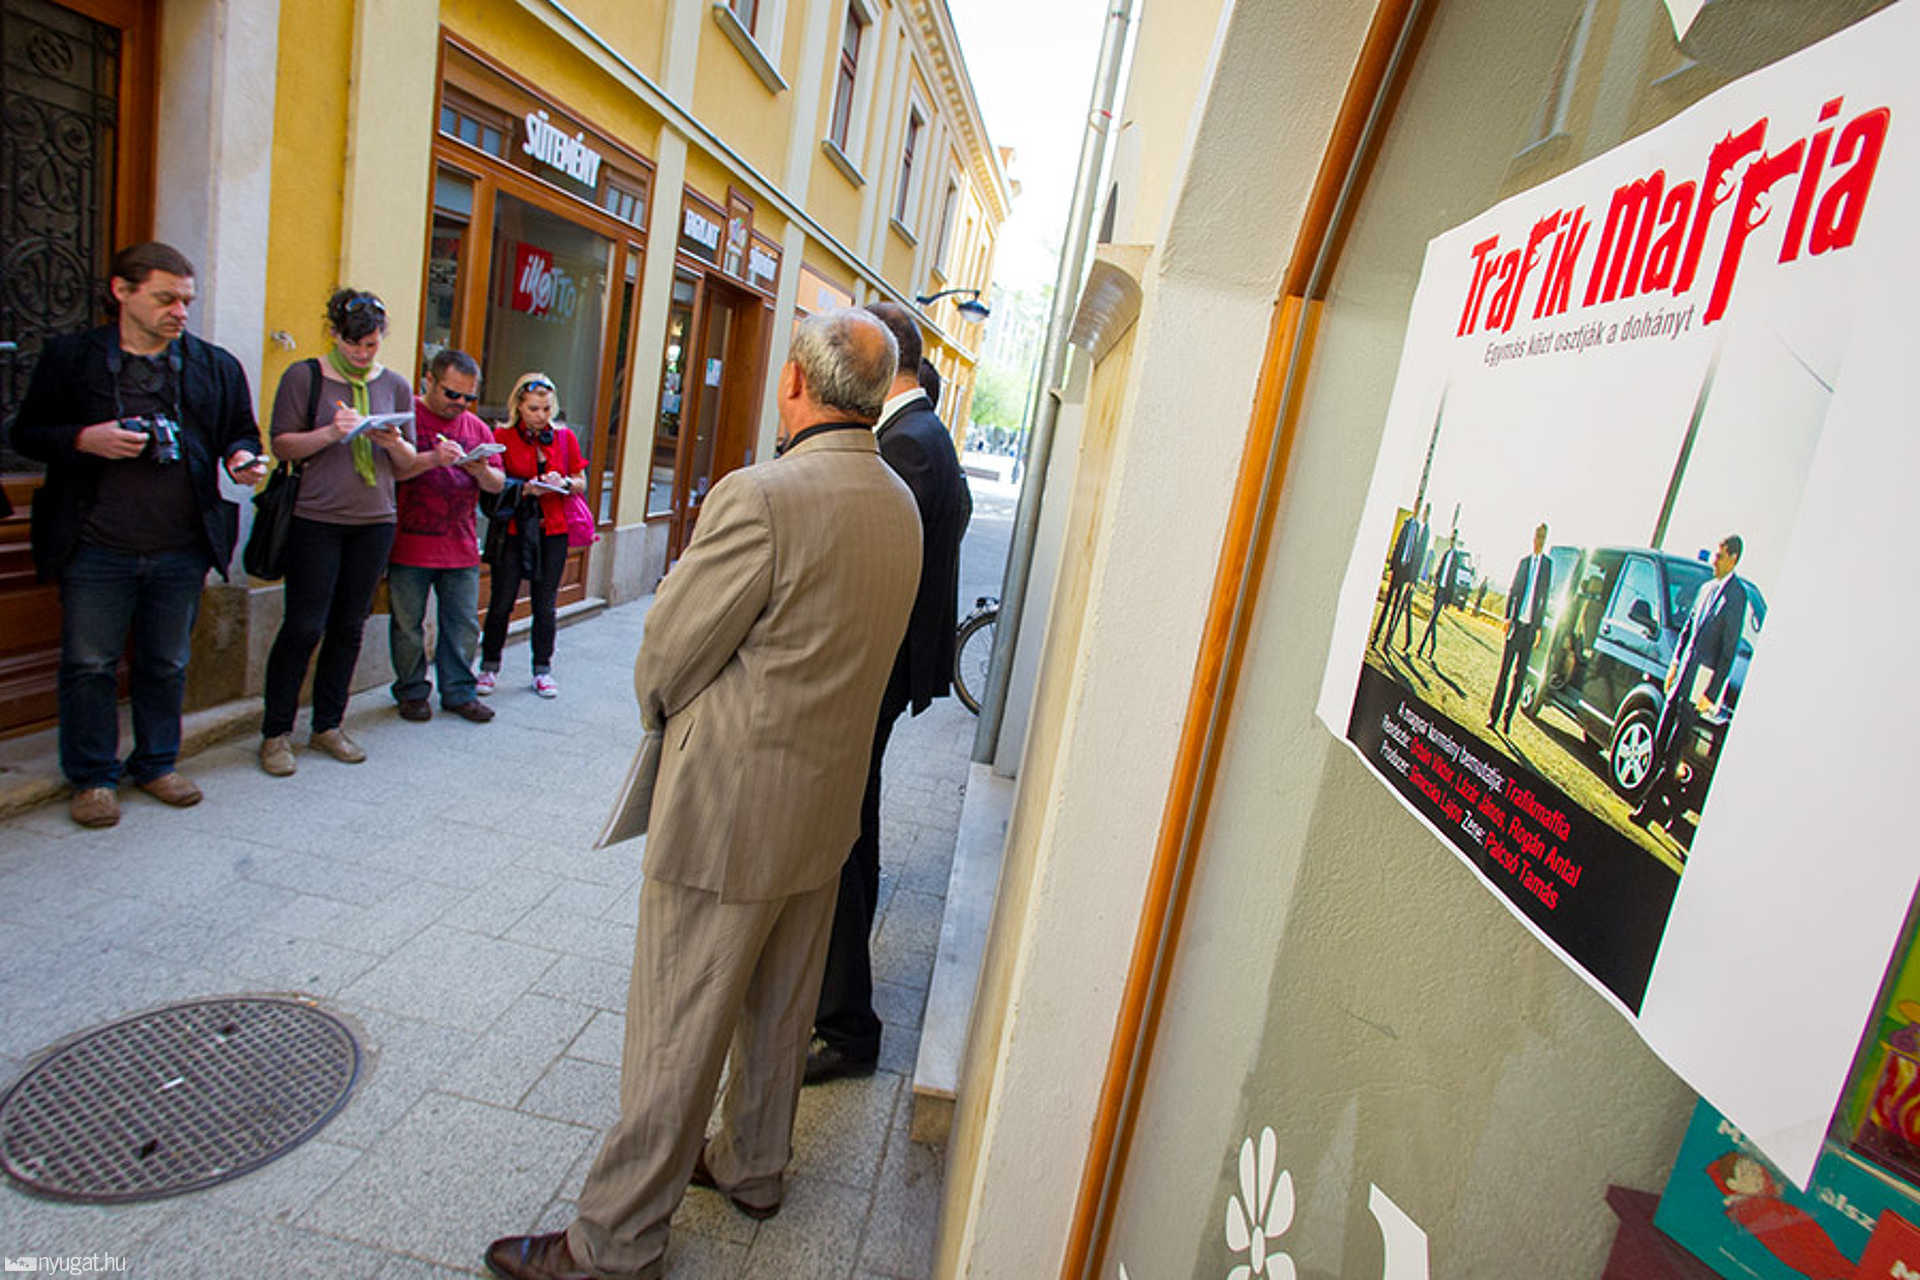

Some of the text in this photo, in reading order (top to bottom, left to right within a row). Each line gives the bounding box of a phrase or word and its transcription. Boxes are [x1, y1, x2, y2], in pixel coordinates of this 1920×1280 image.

[522, 109, 602, 188] SÜTEMÉNY
[1483, 303, 1696, 368] Egymás közt osztják a dohányt
[1504, 776, 1571, 843] Trafikmaffia
[1508, 815, 1546, 860] Rogán
[1543, 845, 1583, 889] Antal
[1519, 858, 1559, 911] Tamás
